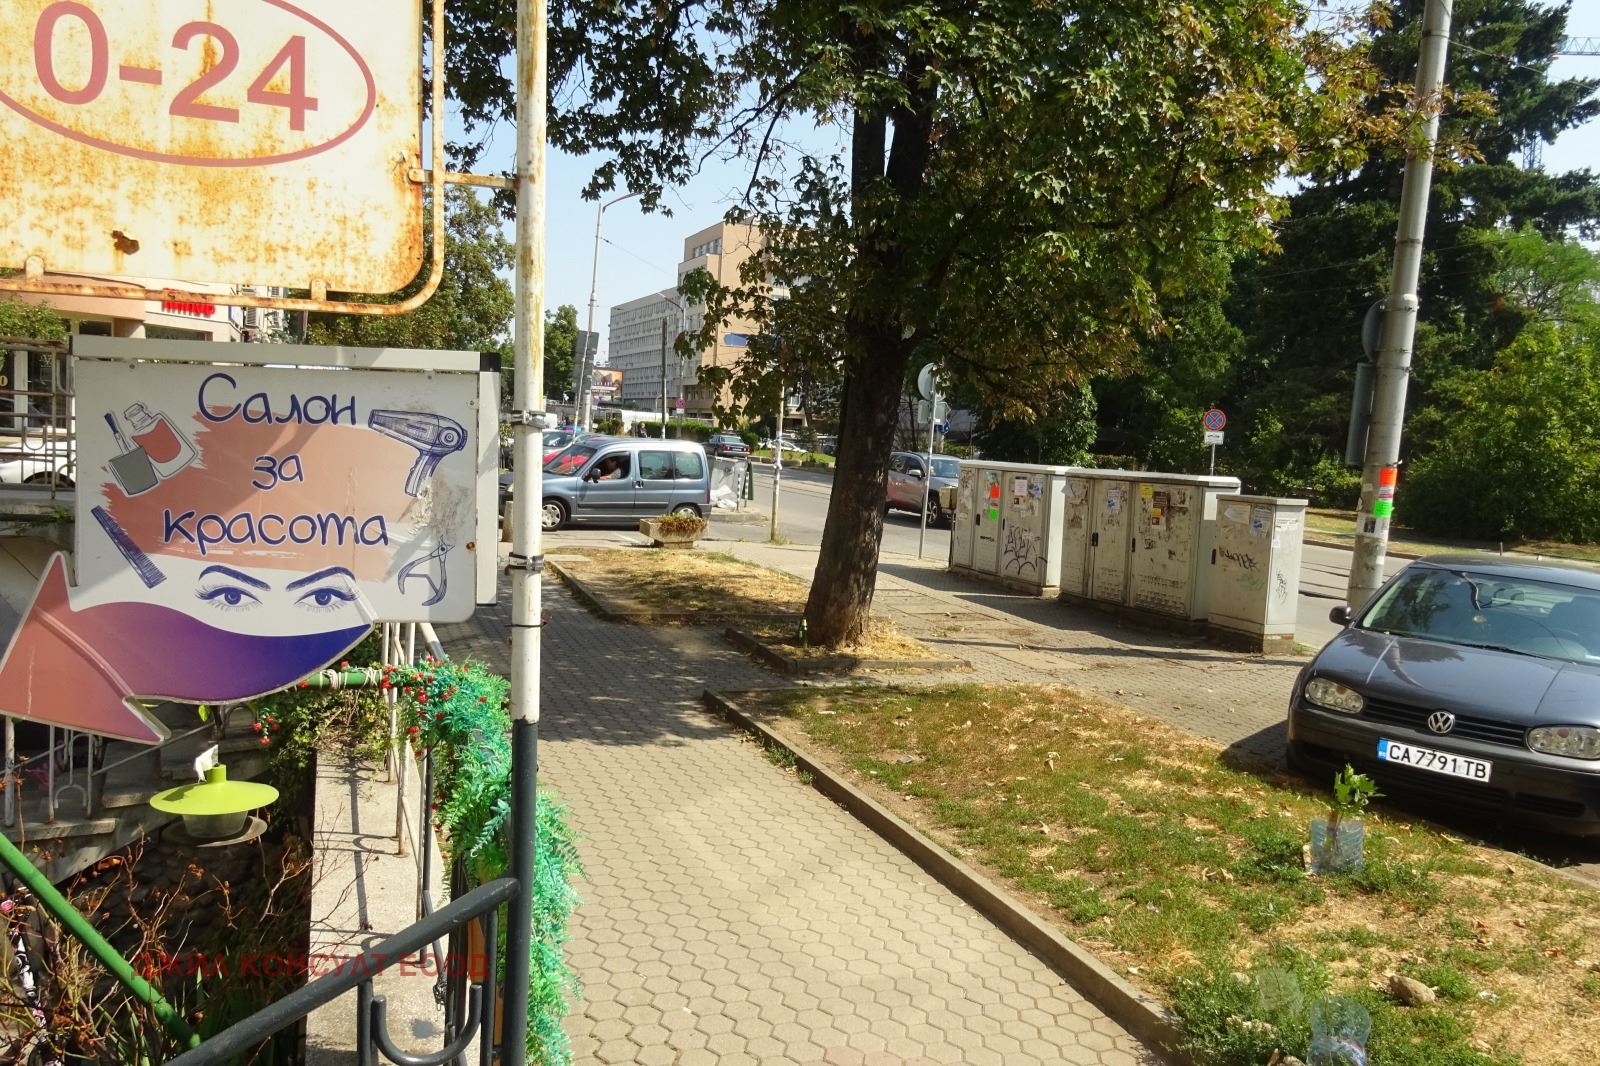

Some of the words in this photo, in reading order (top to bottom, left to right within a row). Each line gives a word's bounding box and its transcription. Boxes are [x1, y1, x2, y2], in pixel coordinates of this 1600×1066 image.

[34, 1, 319, 131] 0-24
[198, 372, 357, 425] Салон
[251, 454, 304, 489] за
[162, 508, 389, 556] красота
